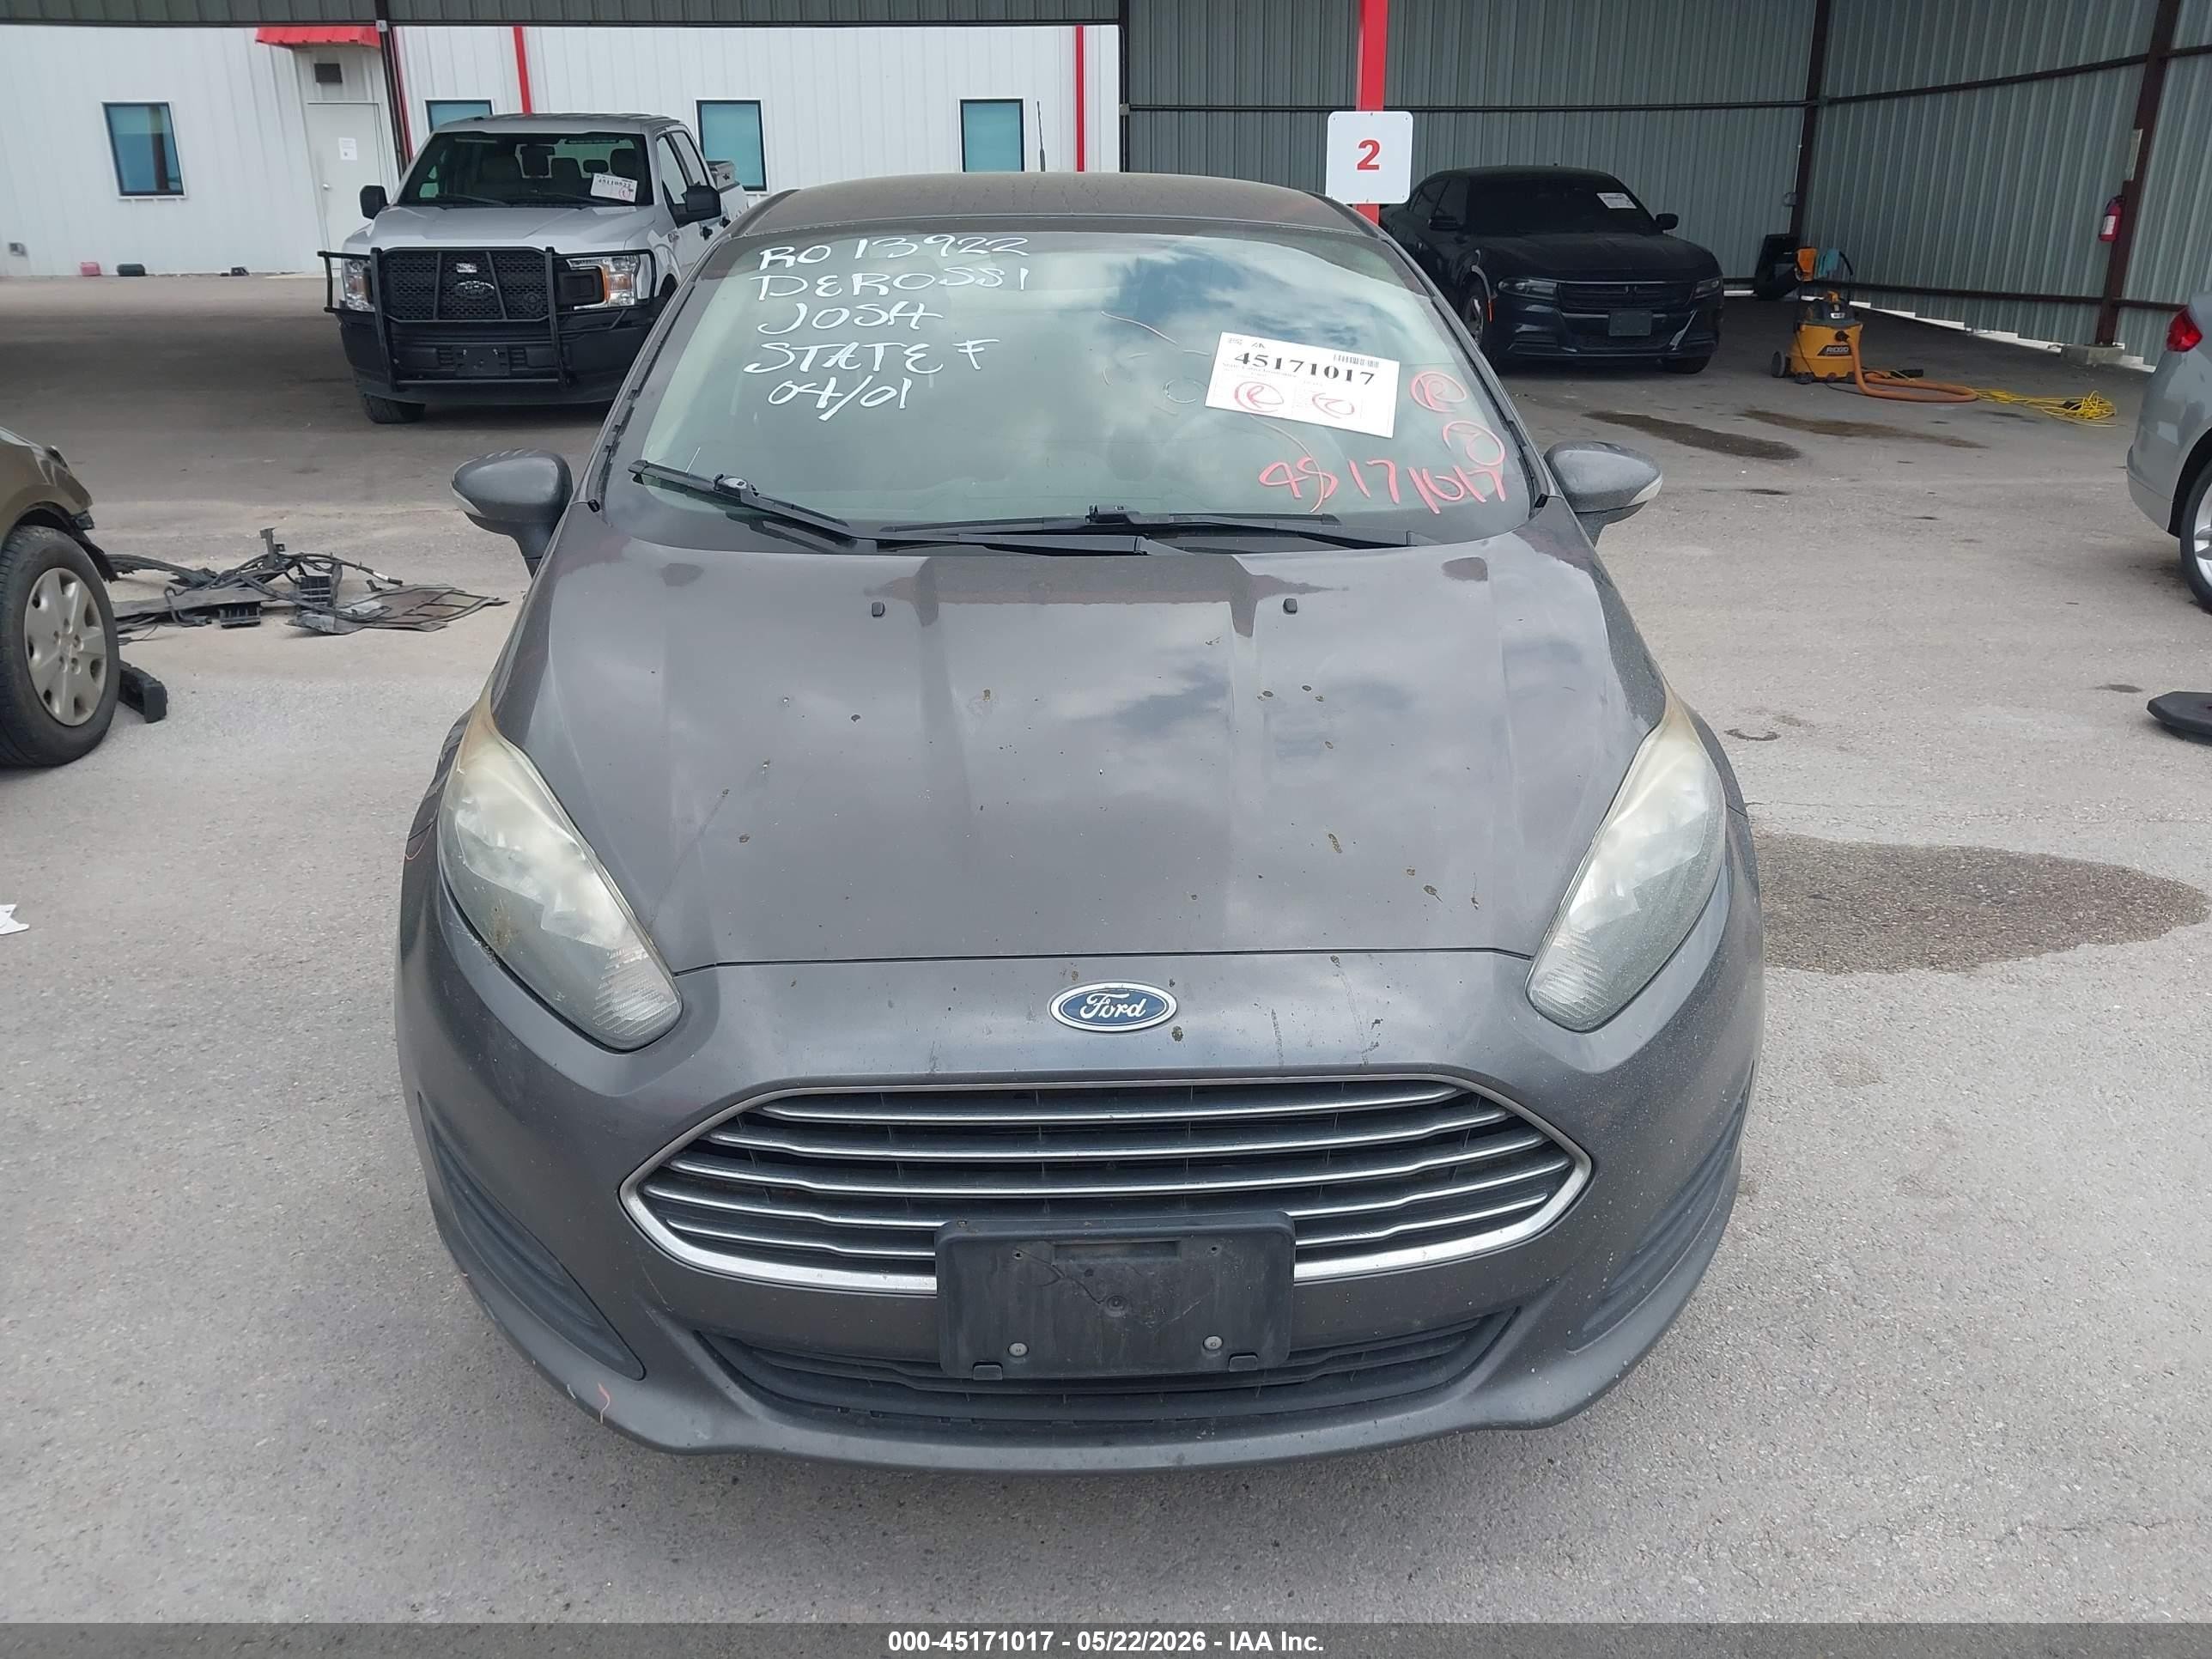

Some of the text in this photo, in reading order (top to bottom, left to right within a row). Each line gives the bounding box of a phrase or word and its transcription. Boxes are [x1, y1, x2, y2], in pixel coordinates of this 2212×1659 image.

[1357, 139, 1380, 170] 2
[759, 234, 1030, 270] RO 13922
[757, 301, 944, 334] JOSH
[744, 338, 1000, 374] STATE F
[1234, 352, 1375, 386] 45171017
[768, 376, 913, 421] 04/01
[1079, 993, 1147, 1019] Ford
